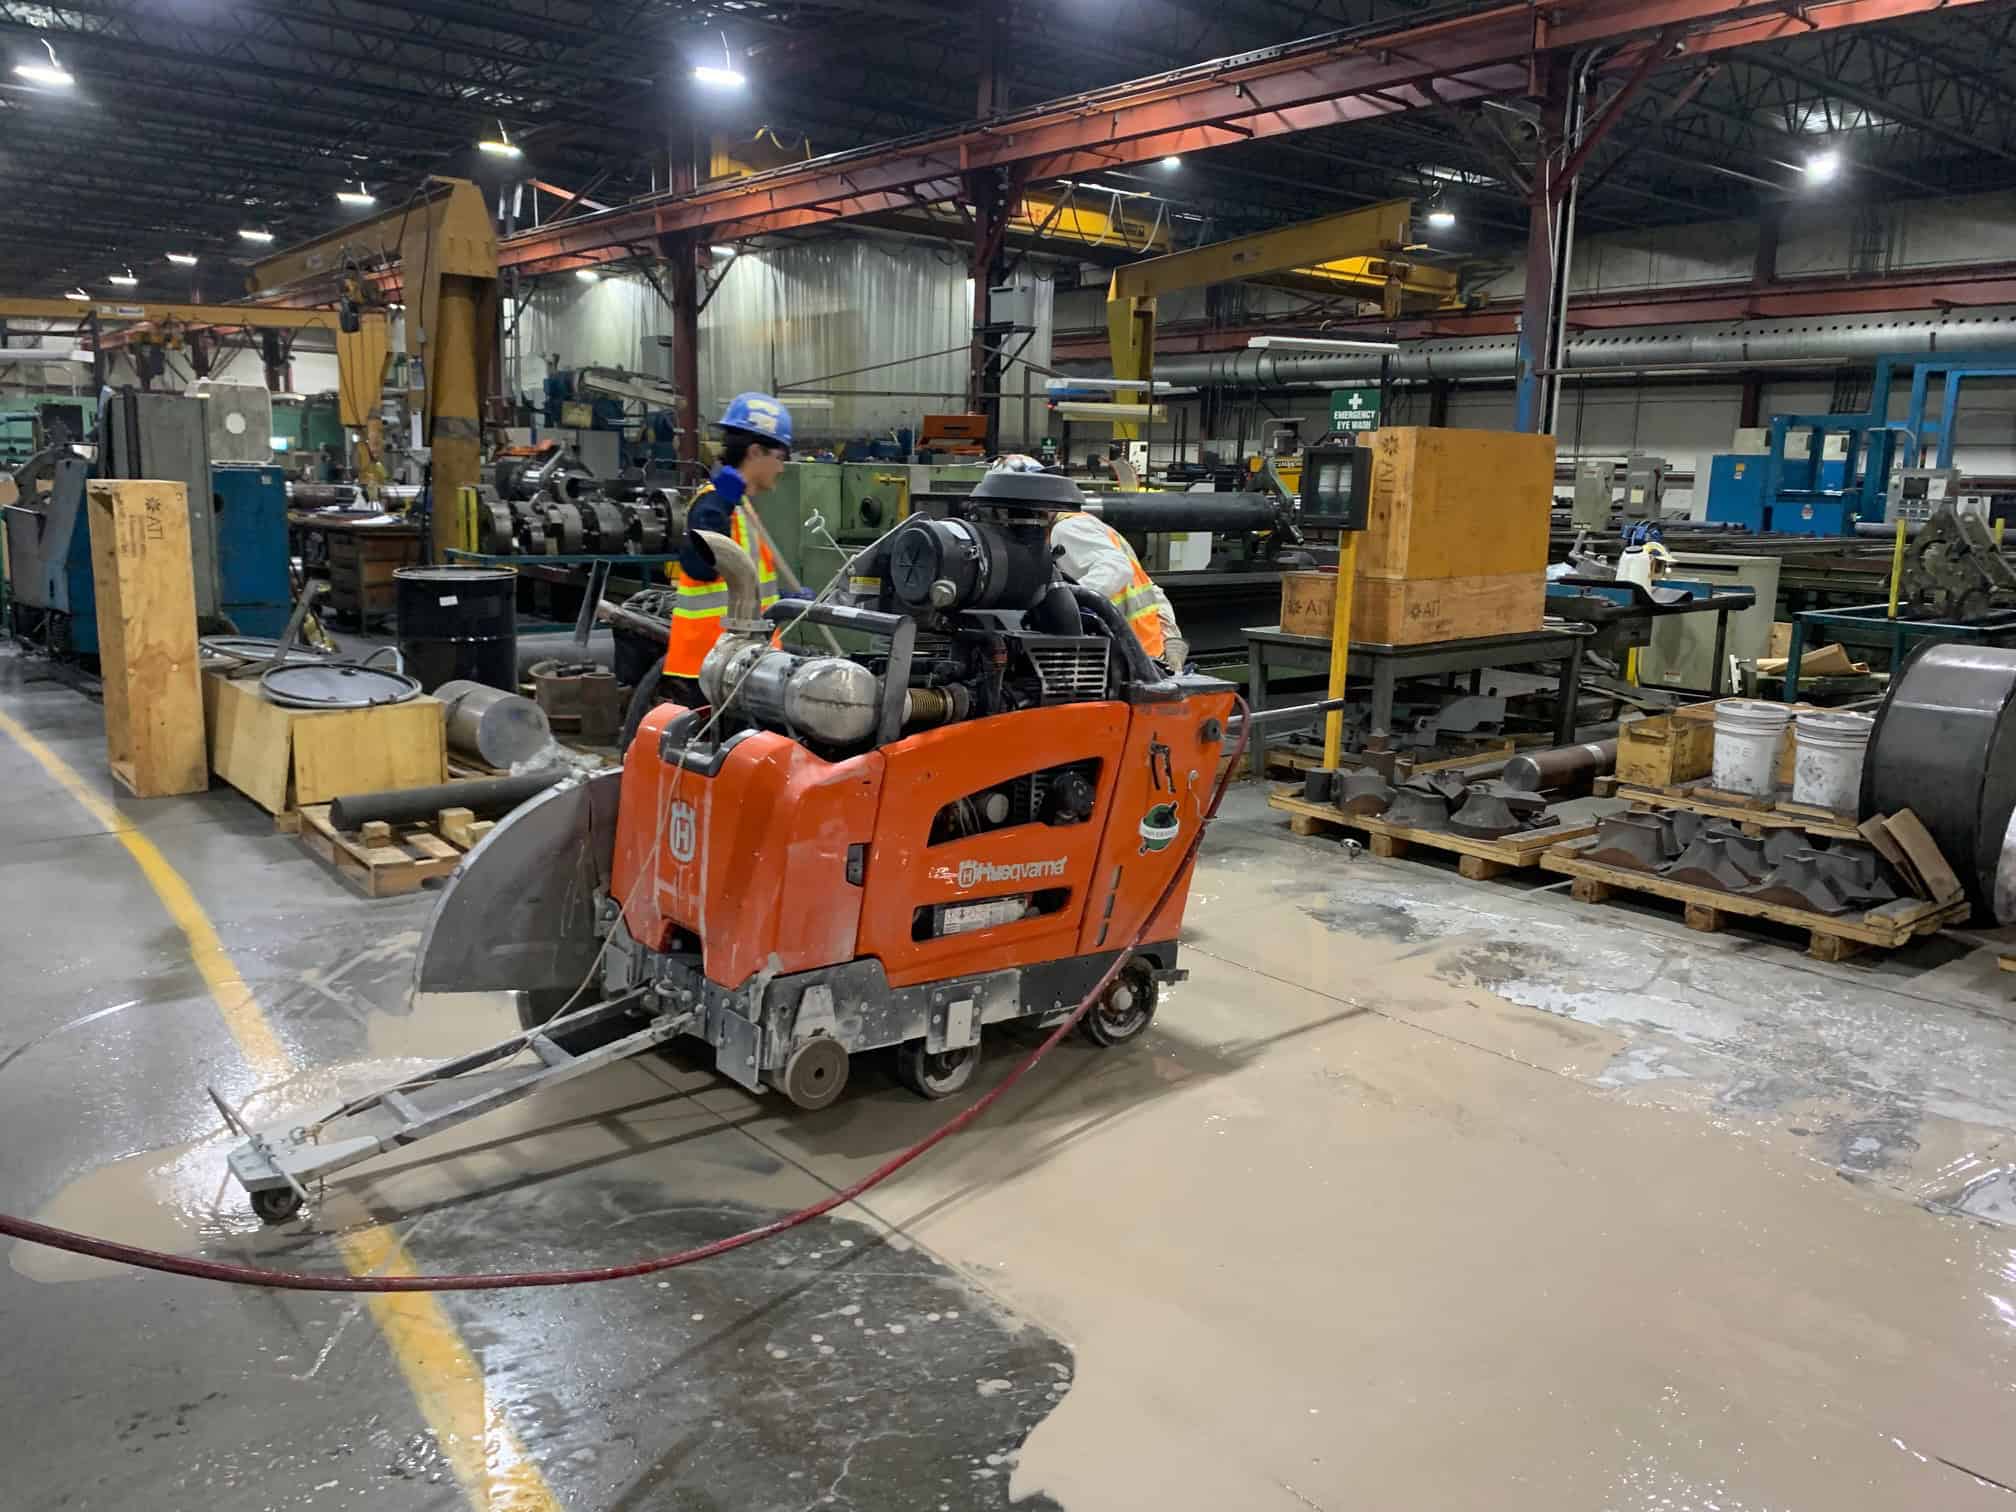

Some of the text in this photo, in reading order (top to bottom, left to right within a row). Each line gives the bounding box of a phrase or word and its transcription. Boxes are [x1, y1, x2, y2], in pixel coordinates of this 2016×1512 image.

[1334, 410, 1375, 420] EMERGENCY
[1336, 420, 1371, 430] EYE WASH
[976, 855, 1068, 882] Husqvarna
